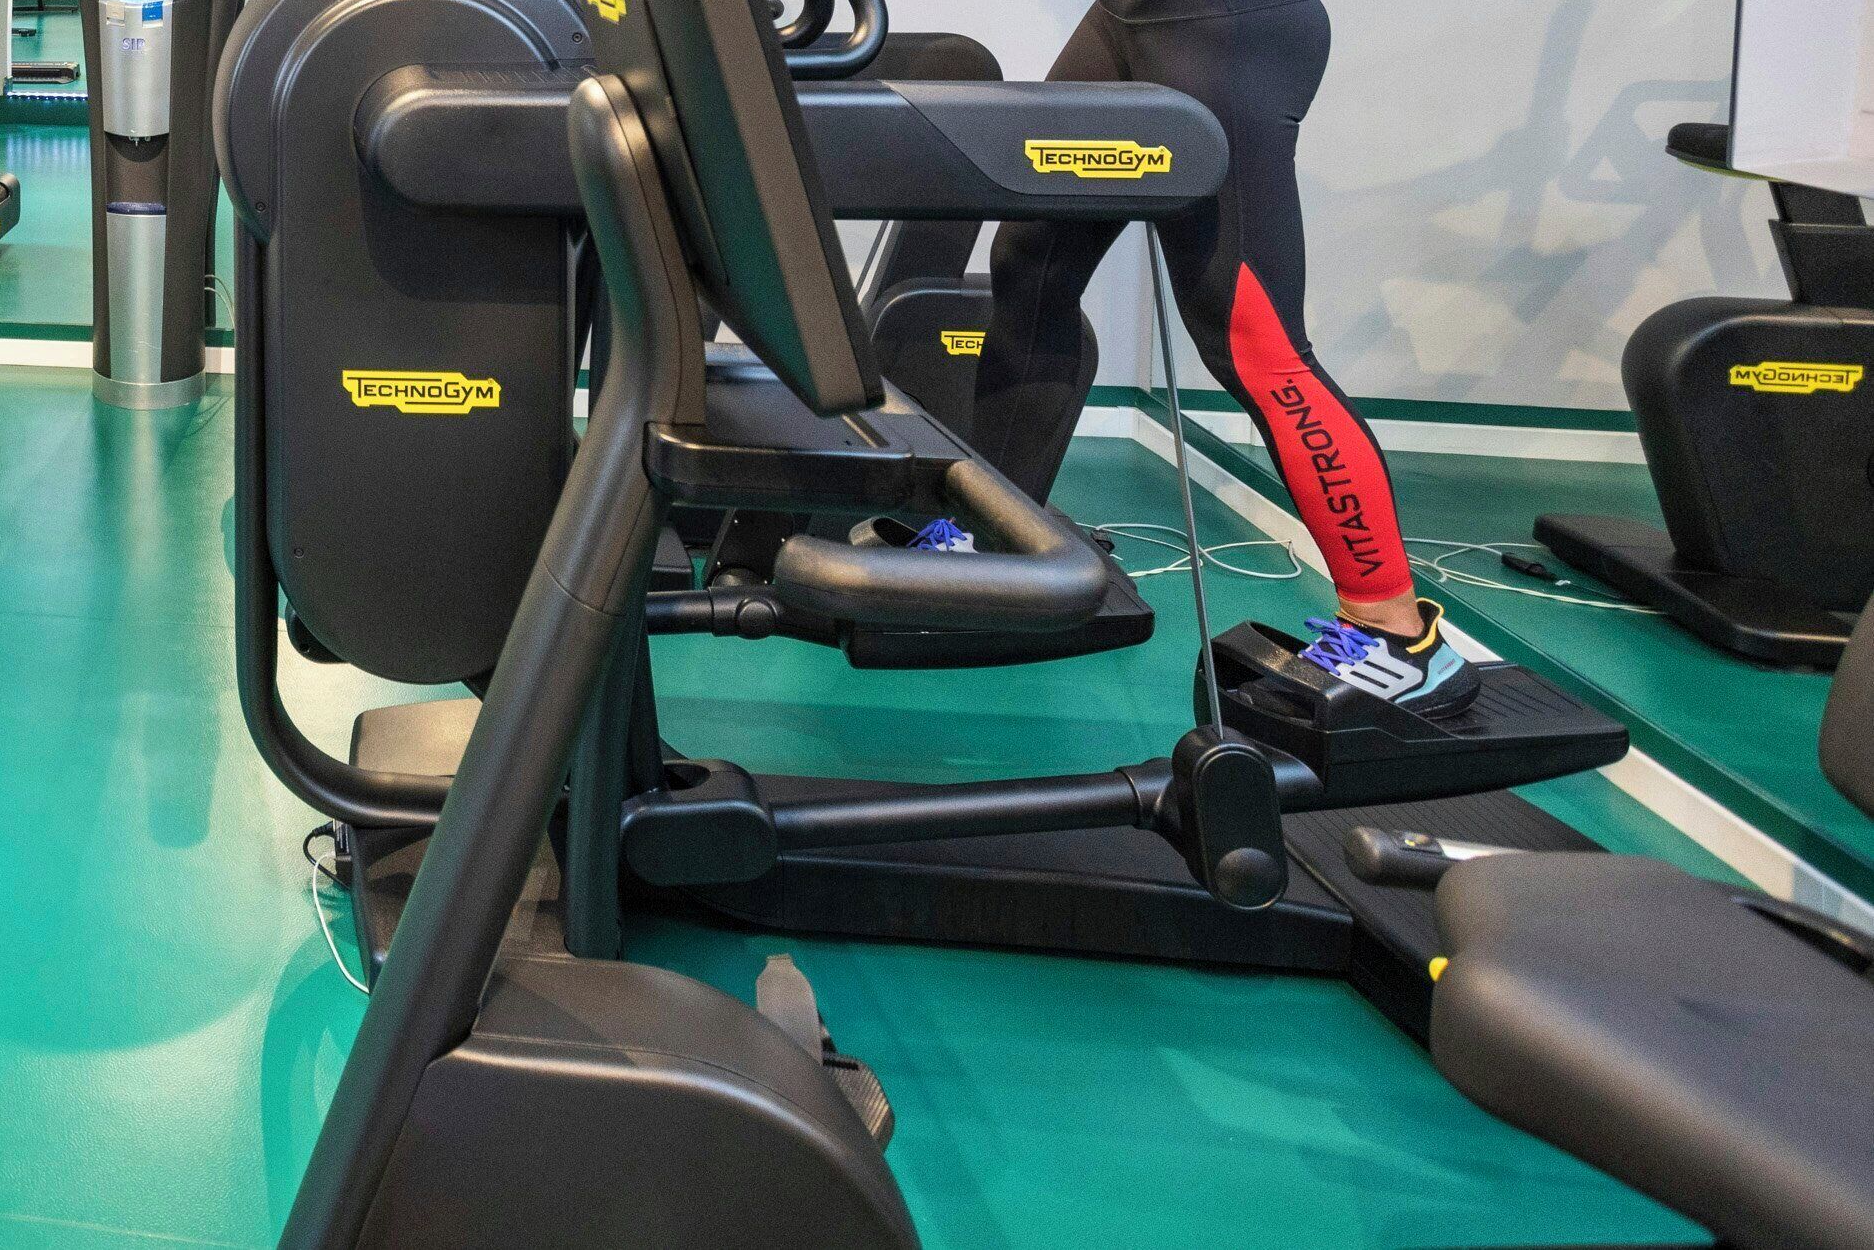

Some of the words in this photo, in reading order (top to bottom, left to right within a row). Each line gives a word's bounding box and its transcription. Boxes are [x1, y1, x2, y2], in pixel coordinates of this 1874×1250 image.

[1030, 146, 1165, 171] TECHNOGYM
[944, 335, 984, 350] TECH
[347, 376, 494, 405] TECHNOGYM
